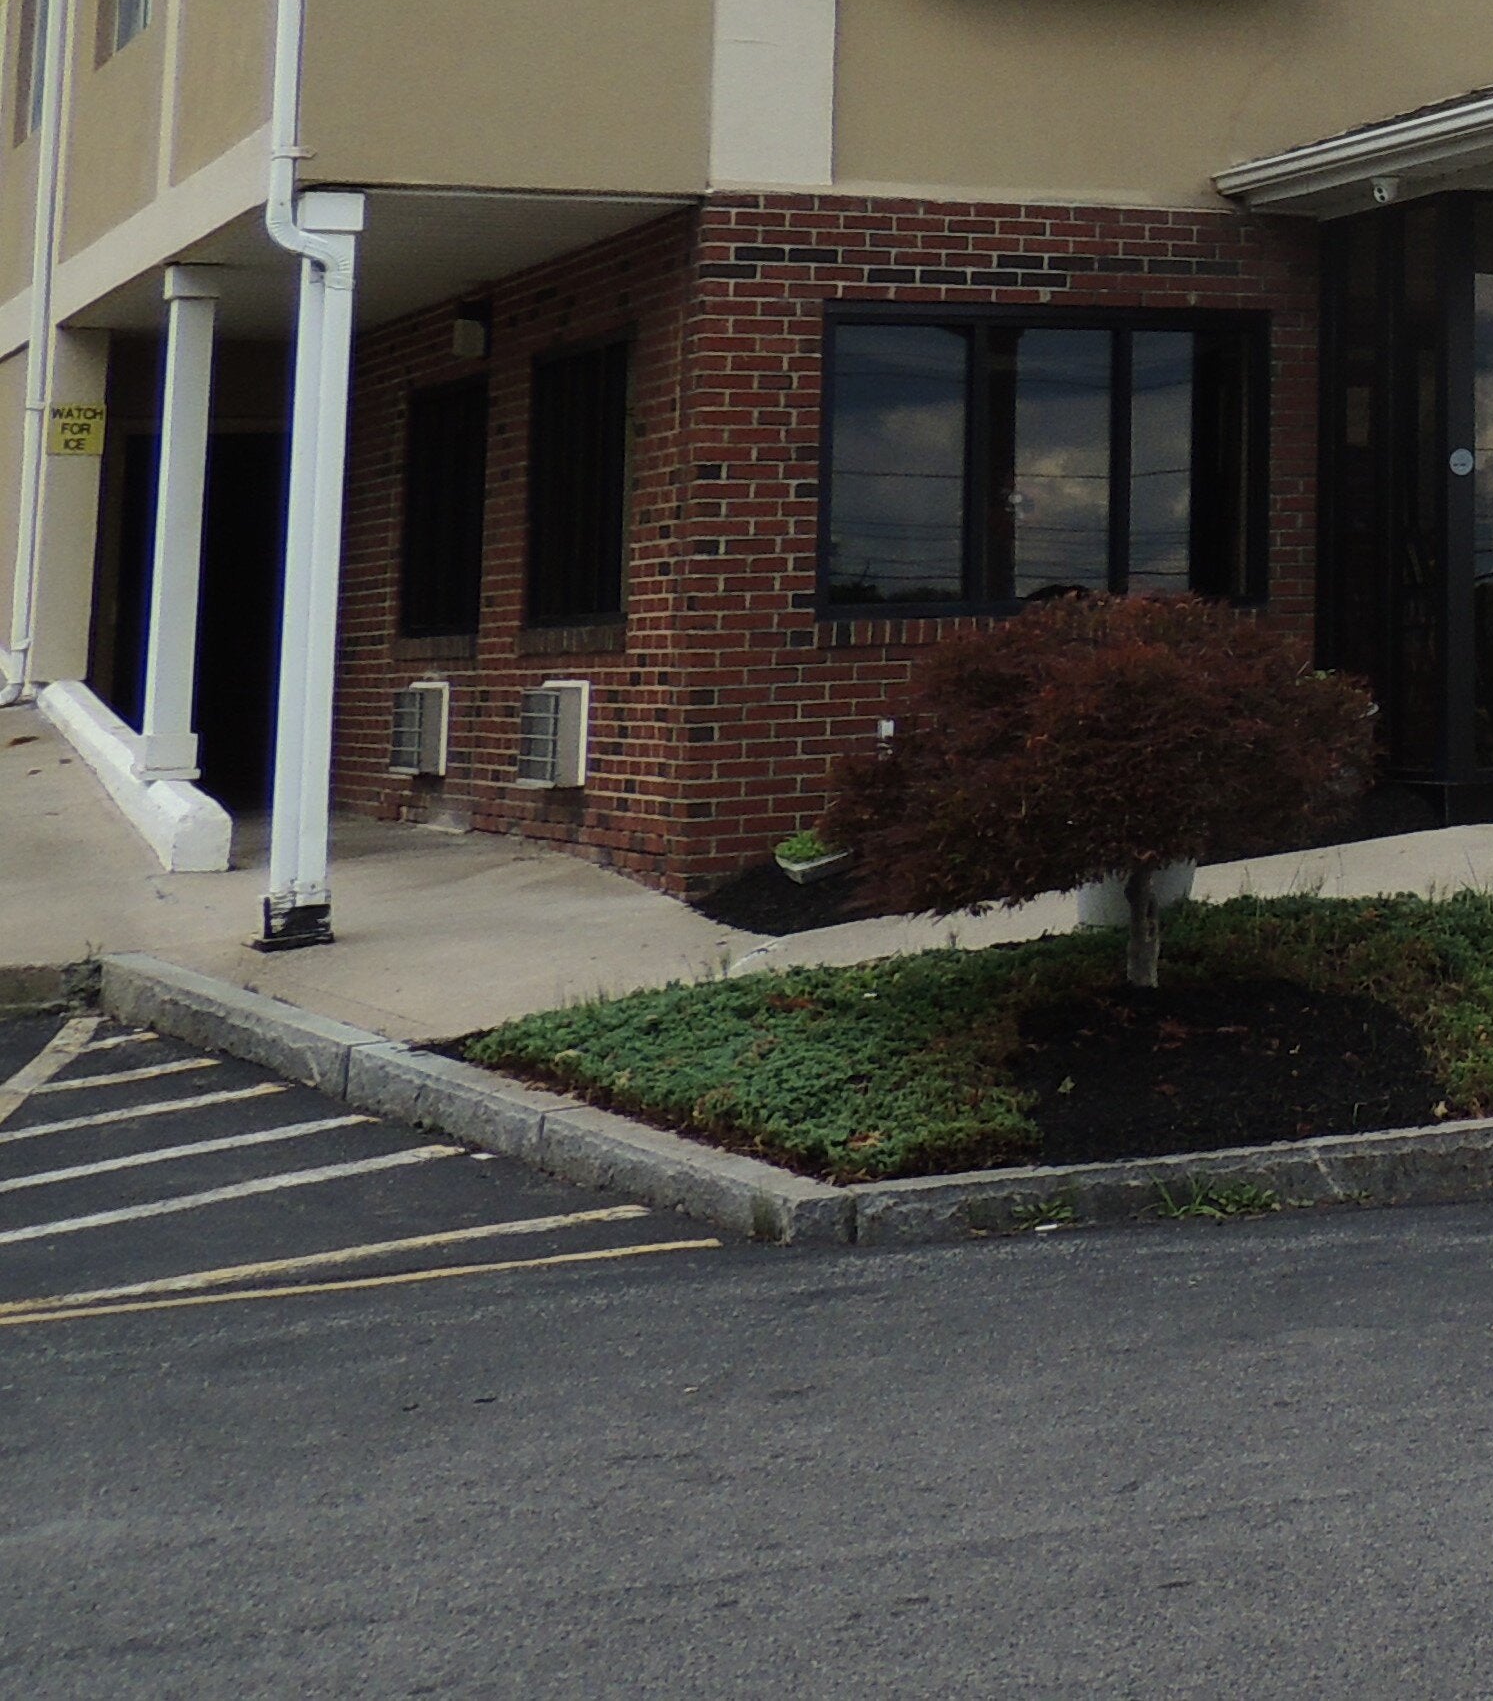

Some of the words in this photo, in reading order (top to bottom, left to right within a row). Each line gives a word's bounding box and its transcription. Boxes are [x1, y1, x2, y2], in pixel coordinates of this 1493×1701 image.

[52, 407, 104, 420] WATCH
[61, 422, 92, 435] FOR
[64, 438, 86, 450] ICE
